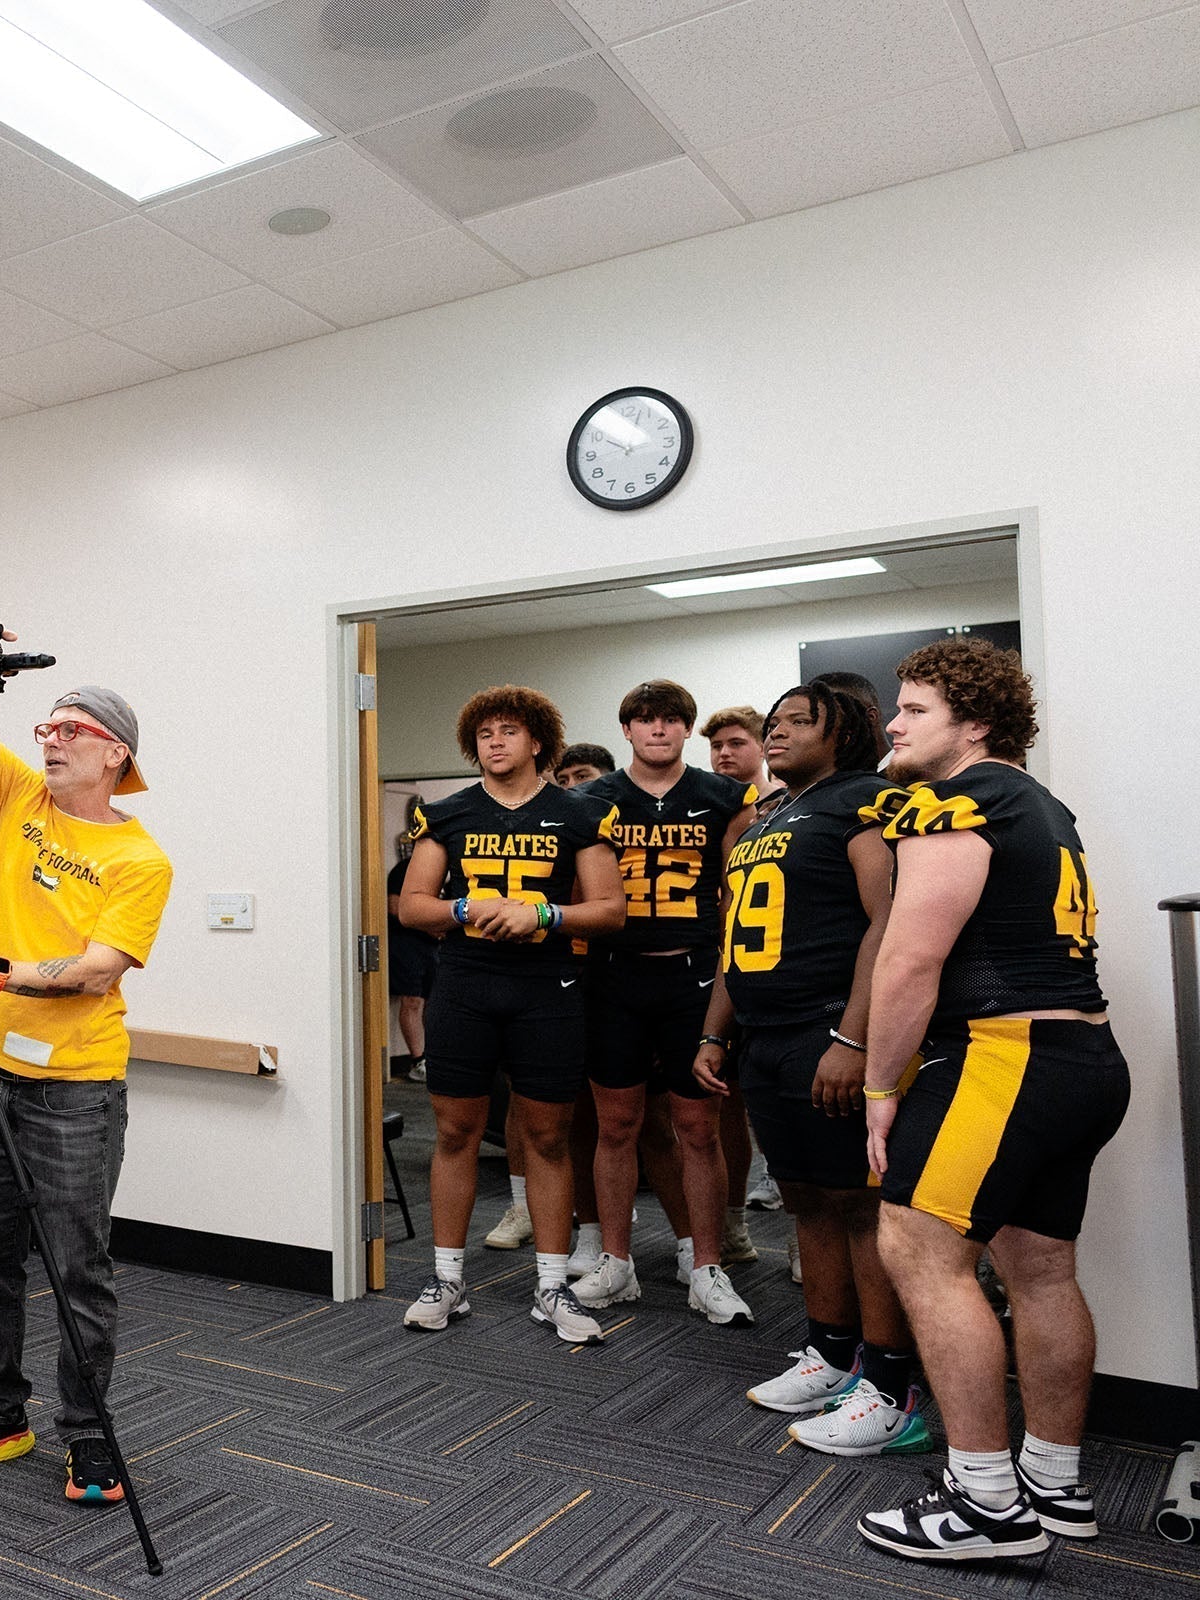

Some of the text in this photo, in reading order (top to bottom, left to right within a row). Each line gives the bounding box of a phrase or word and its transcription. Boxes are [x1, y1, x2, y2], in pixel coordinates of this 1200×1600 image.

[621, 406, 636, 418] 12
[657, 418, 669, 430] 2
[590, 431, 604, 443] 10
[663, 436, 675, 448] 3
[586, 450, 597, 461] 9
[659, 455, 670, 467] 4
[592, 467, 604, 479] 8
[645, 472, 657, 485] 5
[606, 479, 616, 491] 7
[624, 482, 636, 493] 6
[895, 807, 955, 837] 44
[22, 822, 48, 860] PIRAE
[613, 824, 708, 847] PIRATES
[464, 833, 558, 858] PIRATES
[726, 832, 793, 873] PIRATES
[618, 848, 703, 918] 42
[460, 858, 555, 943] 55
